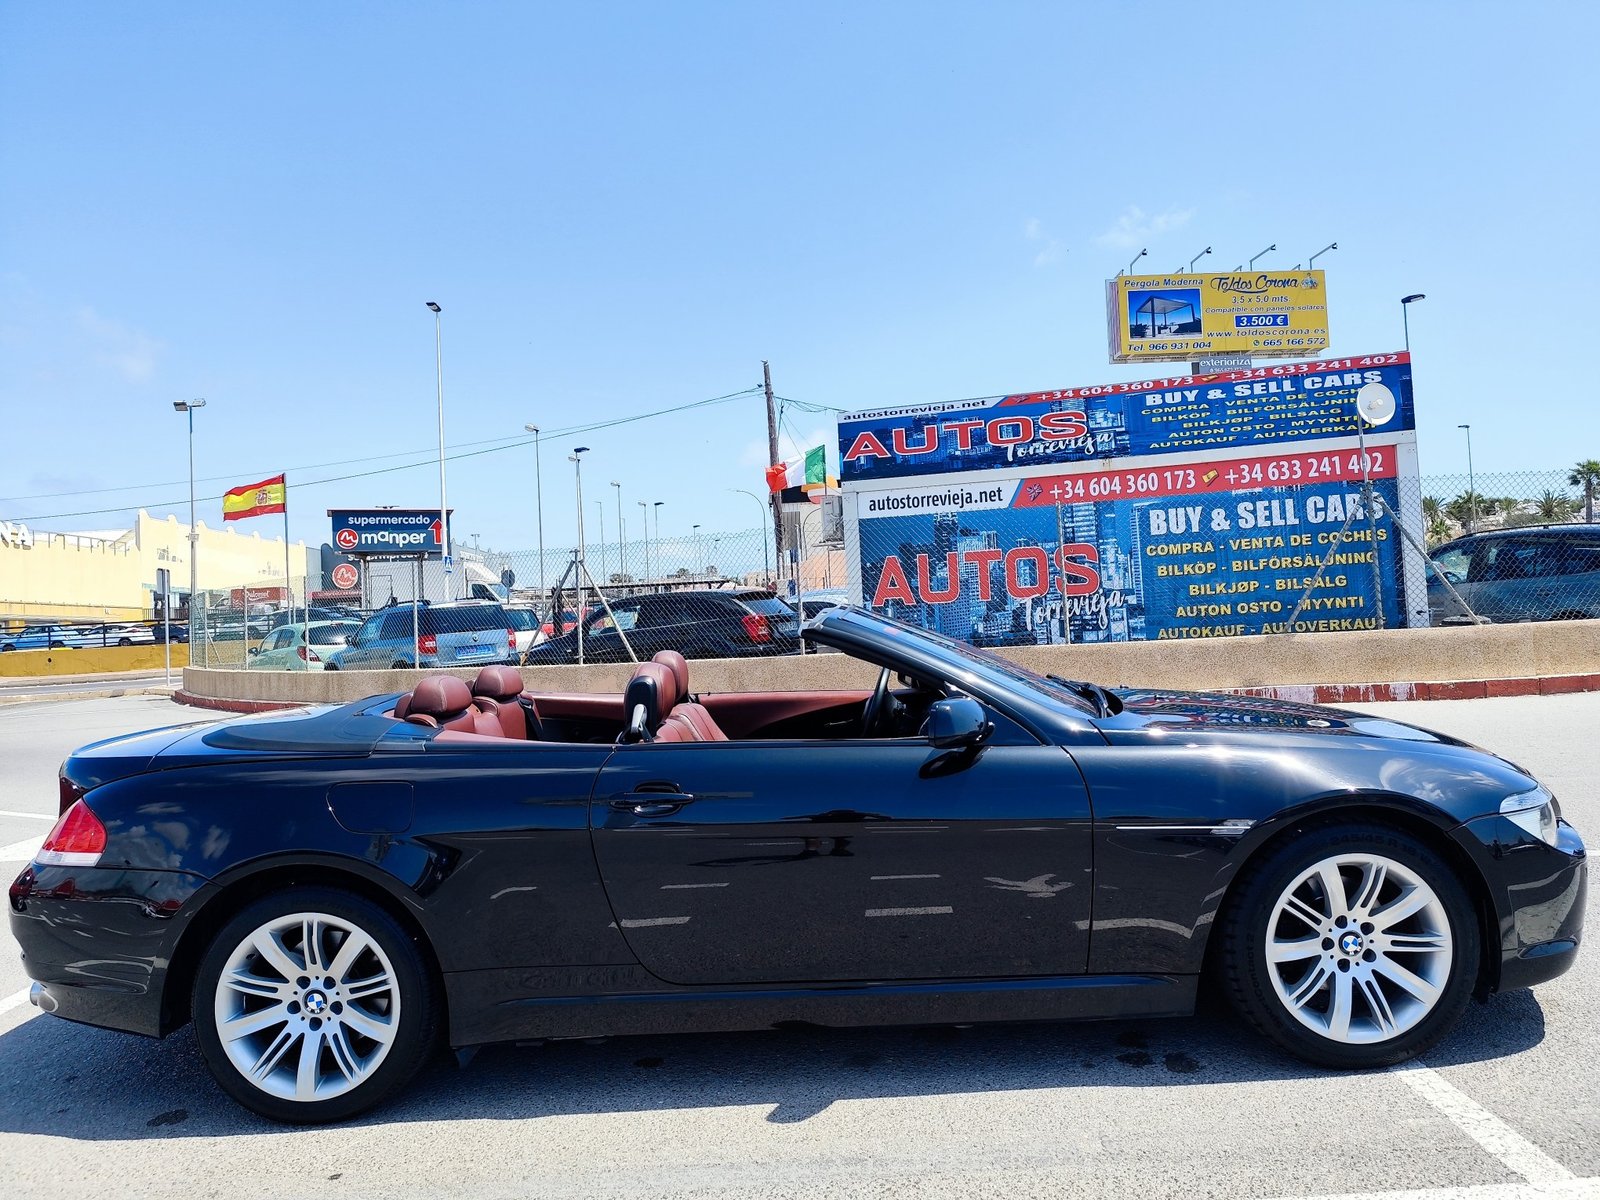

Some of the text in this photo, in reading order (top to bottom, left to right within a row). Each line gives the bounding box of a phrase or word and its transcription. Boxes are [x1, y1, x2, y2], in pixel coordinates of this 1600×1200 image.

[1163, 278, 1204, 286] Moderna
[1210, 274, 1300, 292] Toldos Corona
[1205, 306, 1248, 314] Compatible
[1239, 315, 1285, 326] 3.500 €
[1207, 328, 1326, 338] www.toldoscorona.es
[1307, 337, 1326, 345] 572
[1128, 343, 1145, 351] Tel.
[1171, 341, 1189, 349] 931
[1192, 341, 1212, 349] 004
[1200, 358, 1251, 367] exterioriza
[1226, 369, 1267, 380] +34
[1272, 364, 1309, 375] 633
[1315, 359, 1353, 370] 241
[1359, 354, 1399, 365] 402
[1038, 377, 1194, 401] +34 604 360 173
[1145, 370, 1383, 406] BUY & SELL CARS
[843, 399, 987, 421] autostorrevieja.net
[1141, 403, 1210, 415] COMPRA
[1225, 396, 1280, 407] VENTA
[1286, 393, 1308, 401] DE
[1151, 410, 1211, 423] BILKÖP
[1168, 428, 1225, 439] AUTON
[1230, 422, 1274, 433] OSTO
[1291, 415, 1358, 428] MYYNTI
[1182, 416, 1253, 429] BILKJØP
[1269, 408, 1342, 420] BILSALG
[843, 411, 1088, 462] AUTOS
[1005, 432, 1114, 462] Torrevieja
[1149, 435, 1238, 449] AUTOKAUF
[1224, 452, 1384, 485] +34 633 241 402
[1049, 469, 1196, 499] +34 604 360 173
[868, 487, 1003, 512] autostorrevieja.net
[348, 514, 430, 527] supermercado
[1150, 506, 1203, 536] BUY
[1211, 508, 1230, 531] &
[1236, 498, 1300, 530] SELL
[361, 530, 427, 548] manper
[1146, 541, 1215, 557] COMPRA
[1229, 535, 1285, 551] VENTA
[1290, 533, 1312, 547] DE
[1317, 527, 1388, 546] COCHES
[872, 542, 1100, 608] AUTOS
[1157, 561, 1217, 577] BILKÖP
[1189, 580, 1260, 596] BILKJØP
[1275, 575, 1348, 591] BILSALG
[1019, 594, 1130, 632] Torrevieja
[1175, 604, 1232, 618] AUTON
[1236, 599, 1282, 614] OSTO
[1299, 596, 1364, 611] MYYNTI
[1157, 624, 1245, 640] AUTOKAUF
